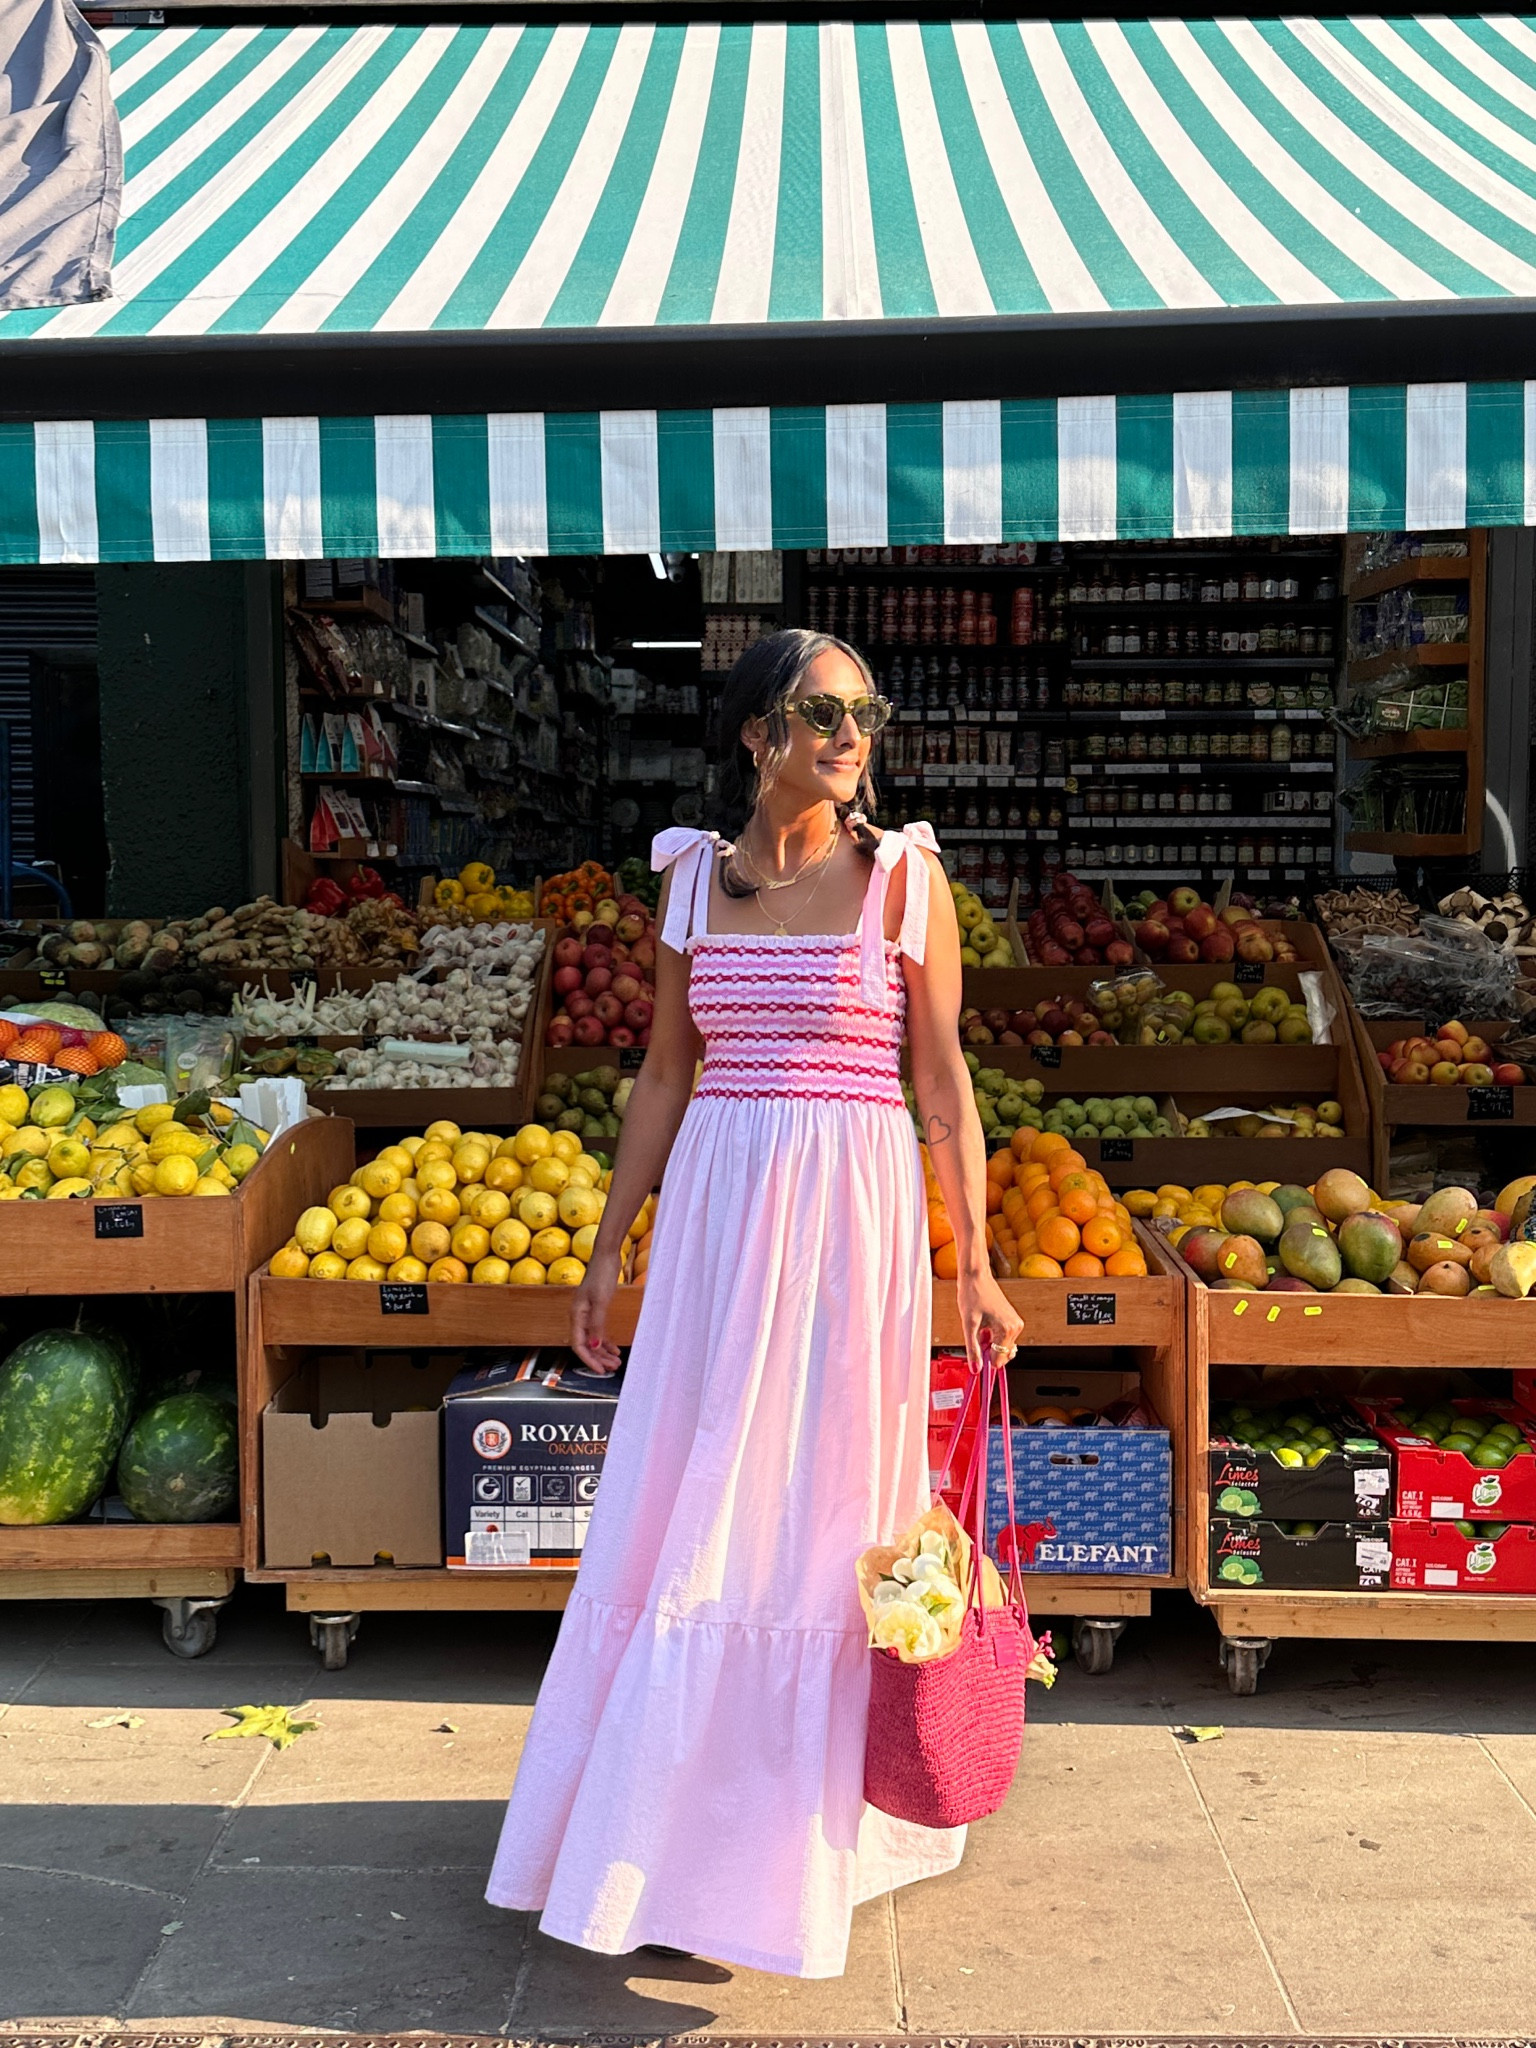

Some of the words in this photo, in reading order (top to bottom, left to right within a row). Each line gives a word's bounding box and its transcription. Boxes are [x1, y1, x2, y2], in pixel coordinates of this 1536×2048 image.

[520, 1424, 608, 1442] ROYAL
[549, 1443, 608, 1455] ORANGES
[1215, 1463, 1259, 1486] Limes
[475, 1510, 500, 1519] Variety
[1217, 1531, 1260, 1554] Limes
[1040, 1544, 1158, 1562] ELEFANT
